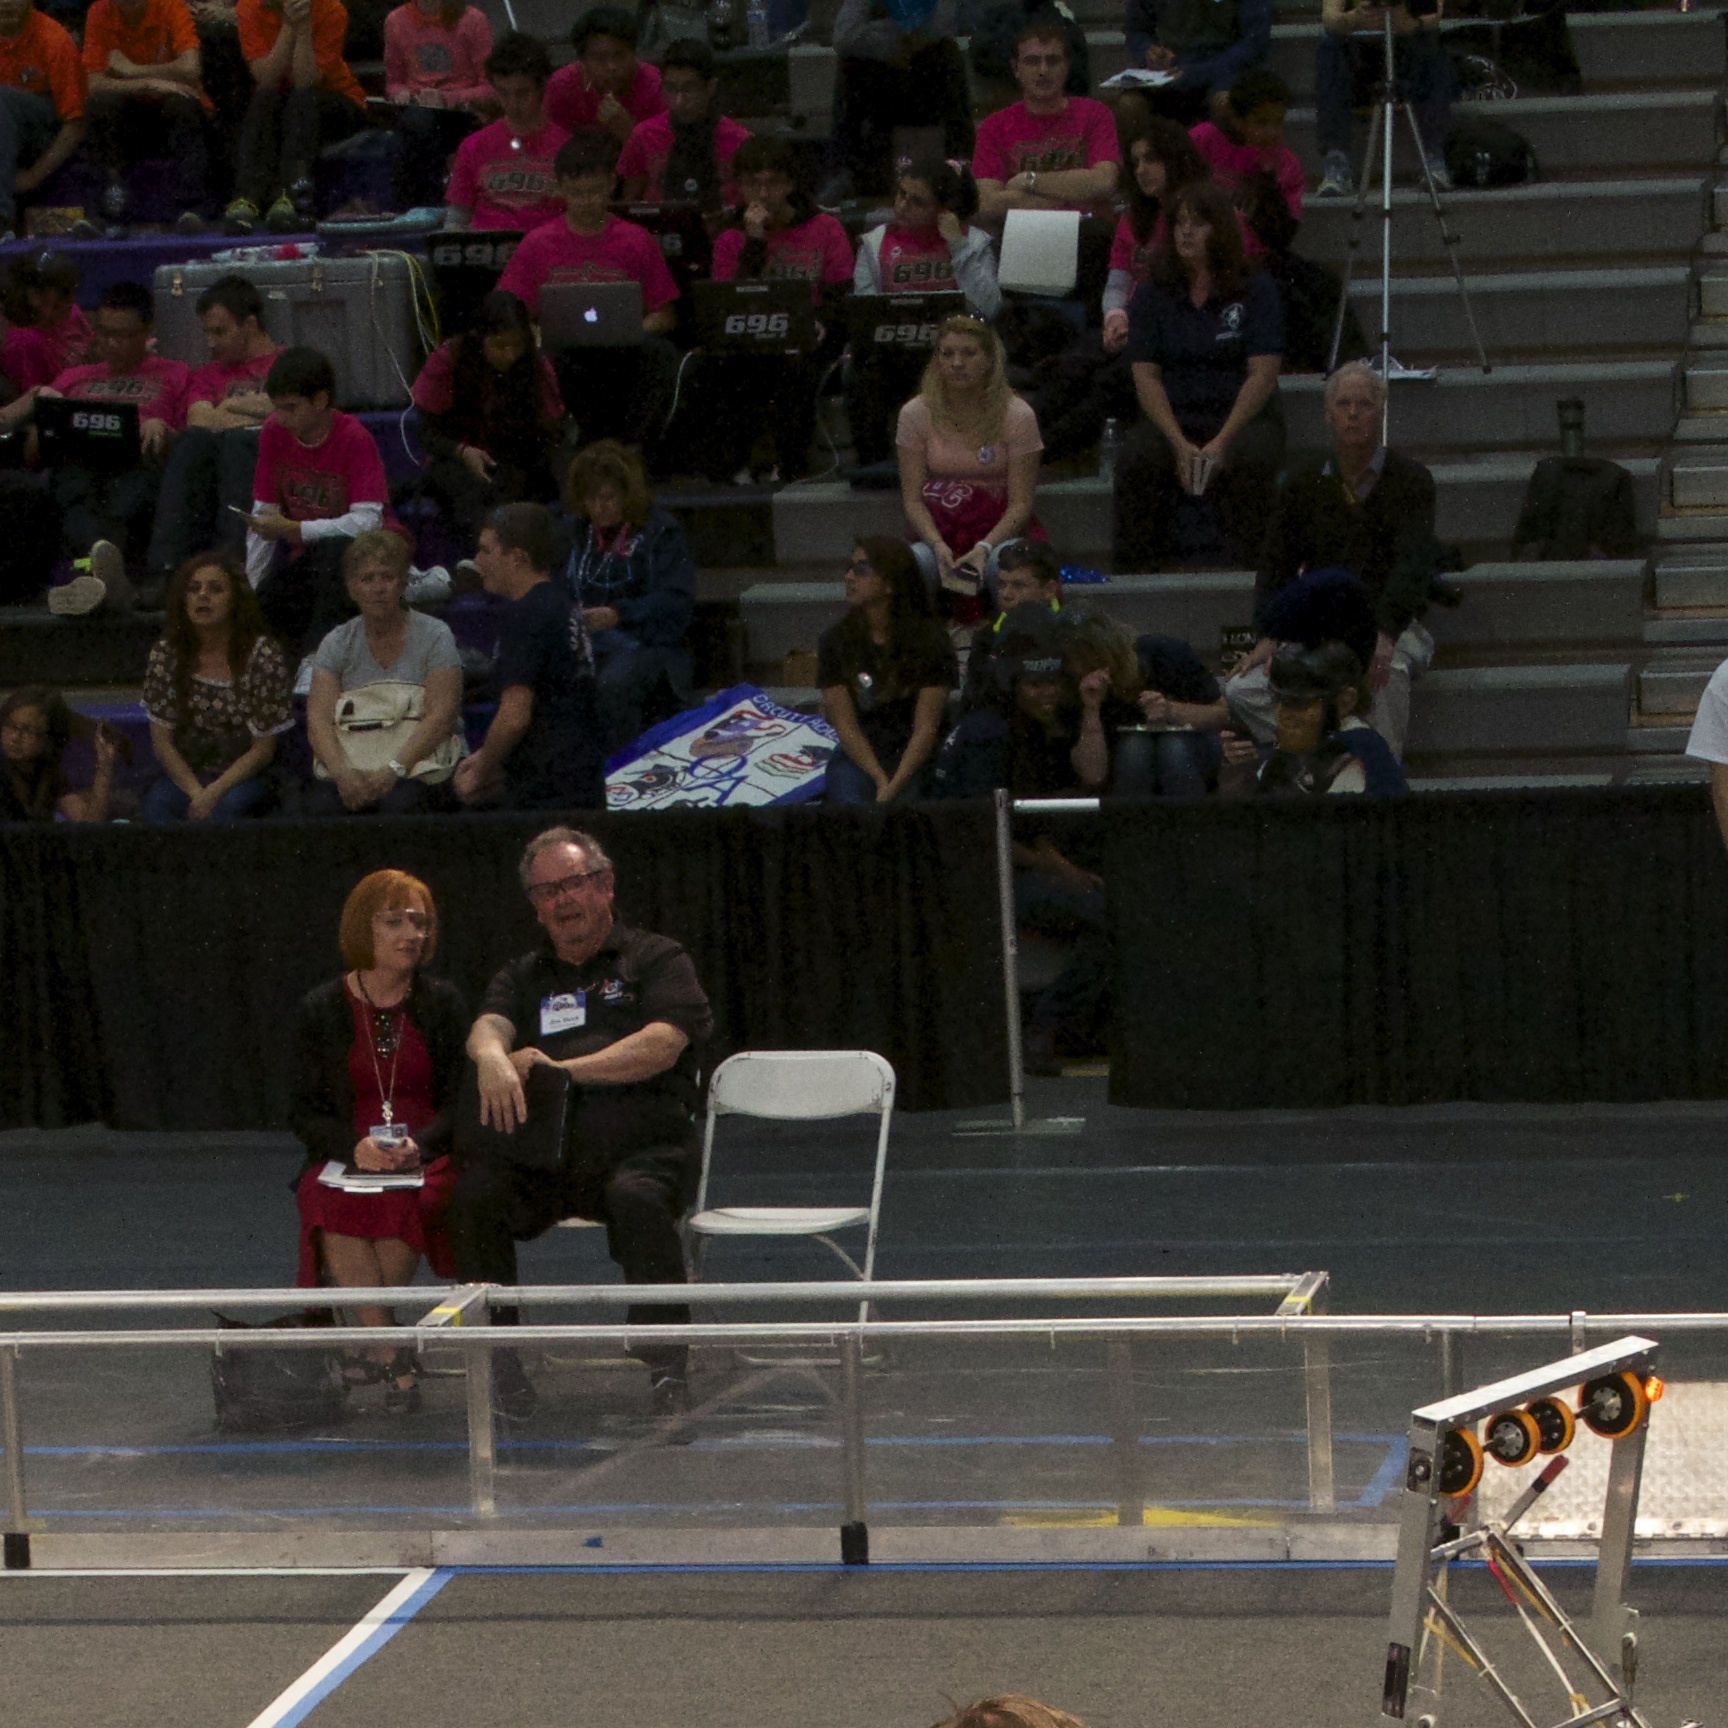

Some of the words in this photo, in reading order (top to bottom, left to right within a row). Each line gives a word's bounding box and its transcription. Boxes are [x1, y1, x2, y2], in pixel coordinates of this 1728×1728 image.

[892, 261, 954, 283] 696
[725, 313, 789, 335] 696
[72, 411, 121, 430] 696
